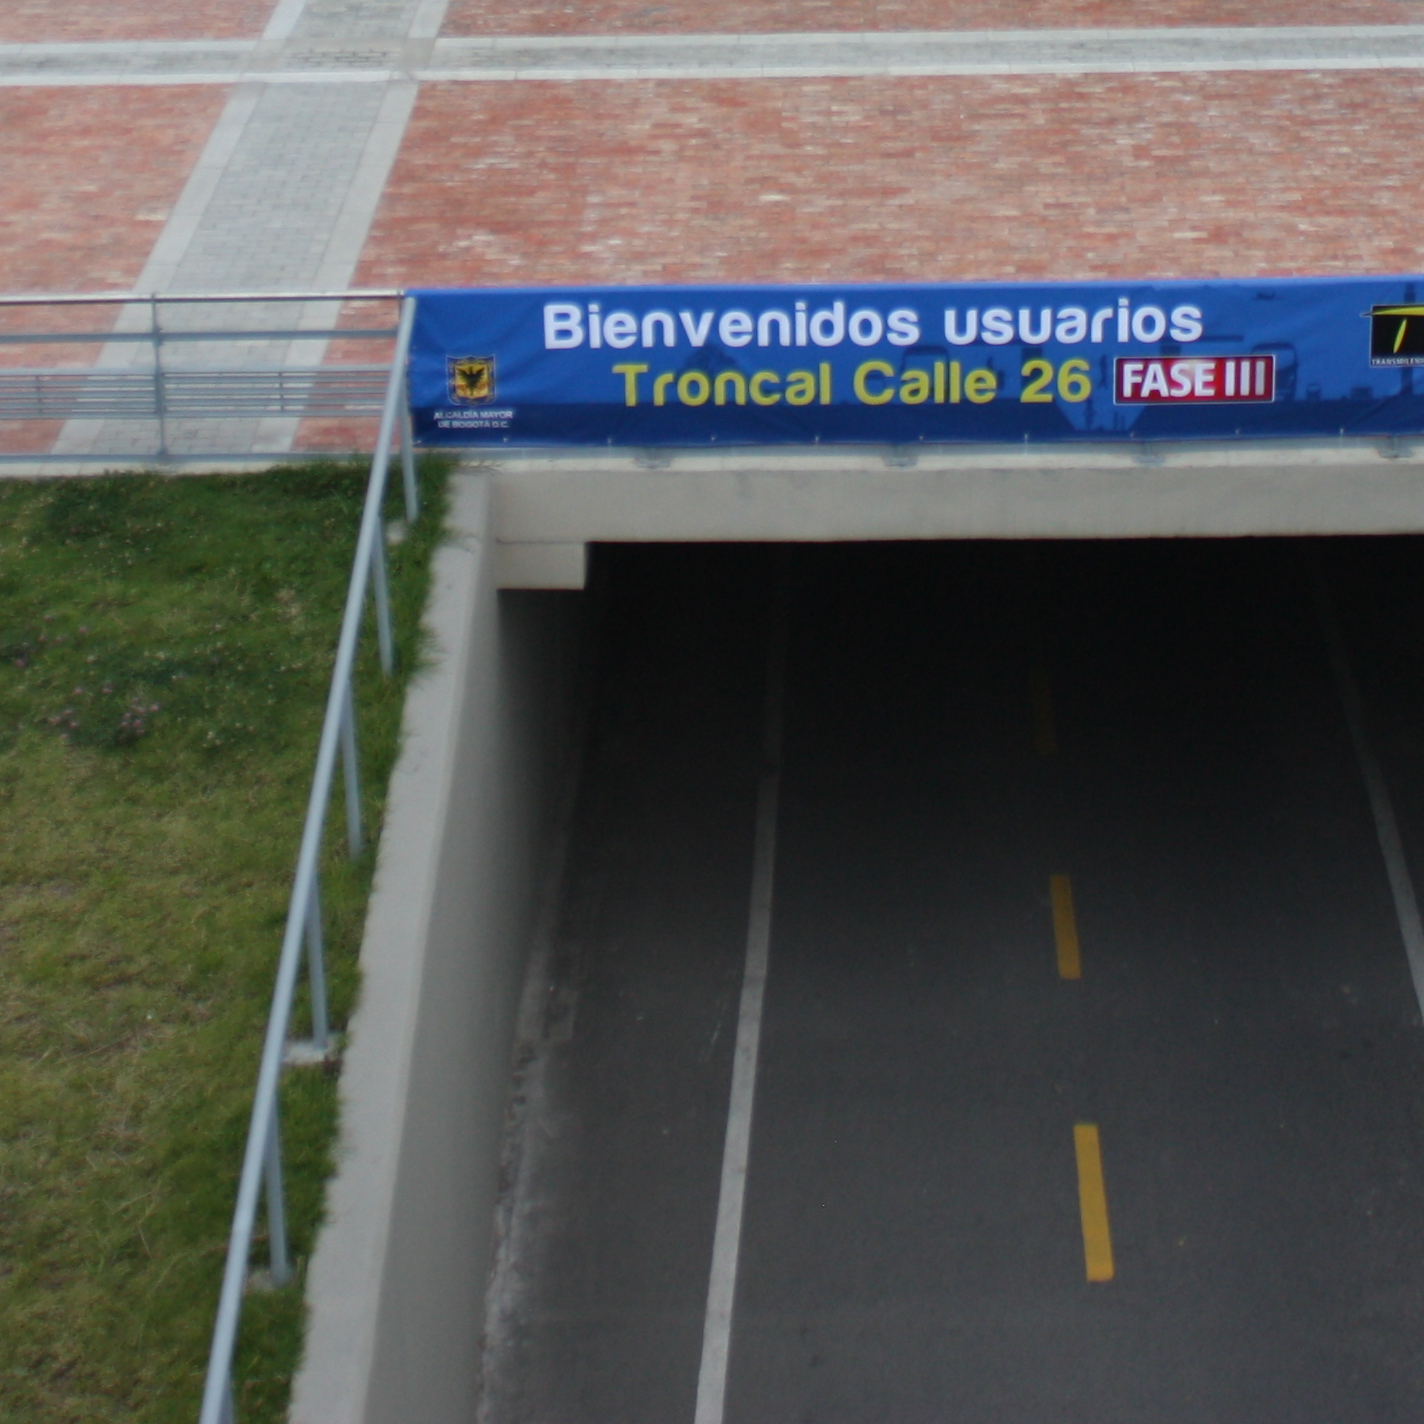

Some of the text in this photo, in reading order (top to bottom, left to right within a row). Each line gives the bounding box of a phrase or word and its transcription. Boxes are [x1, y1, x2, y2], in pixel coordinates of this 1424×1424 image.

[543, 298, 1203, 350] Bienvenidos usuarios
[611, 359, 1265, 407] Troncal Calle 26 FASE III
[480, 409, 514, 419] MAYOR
